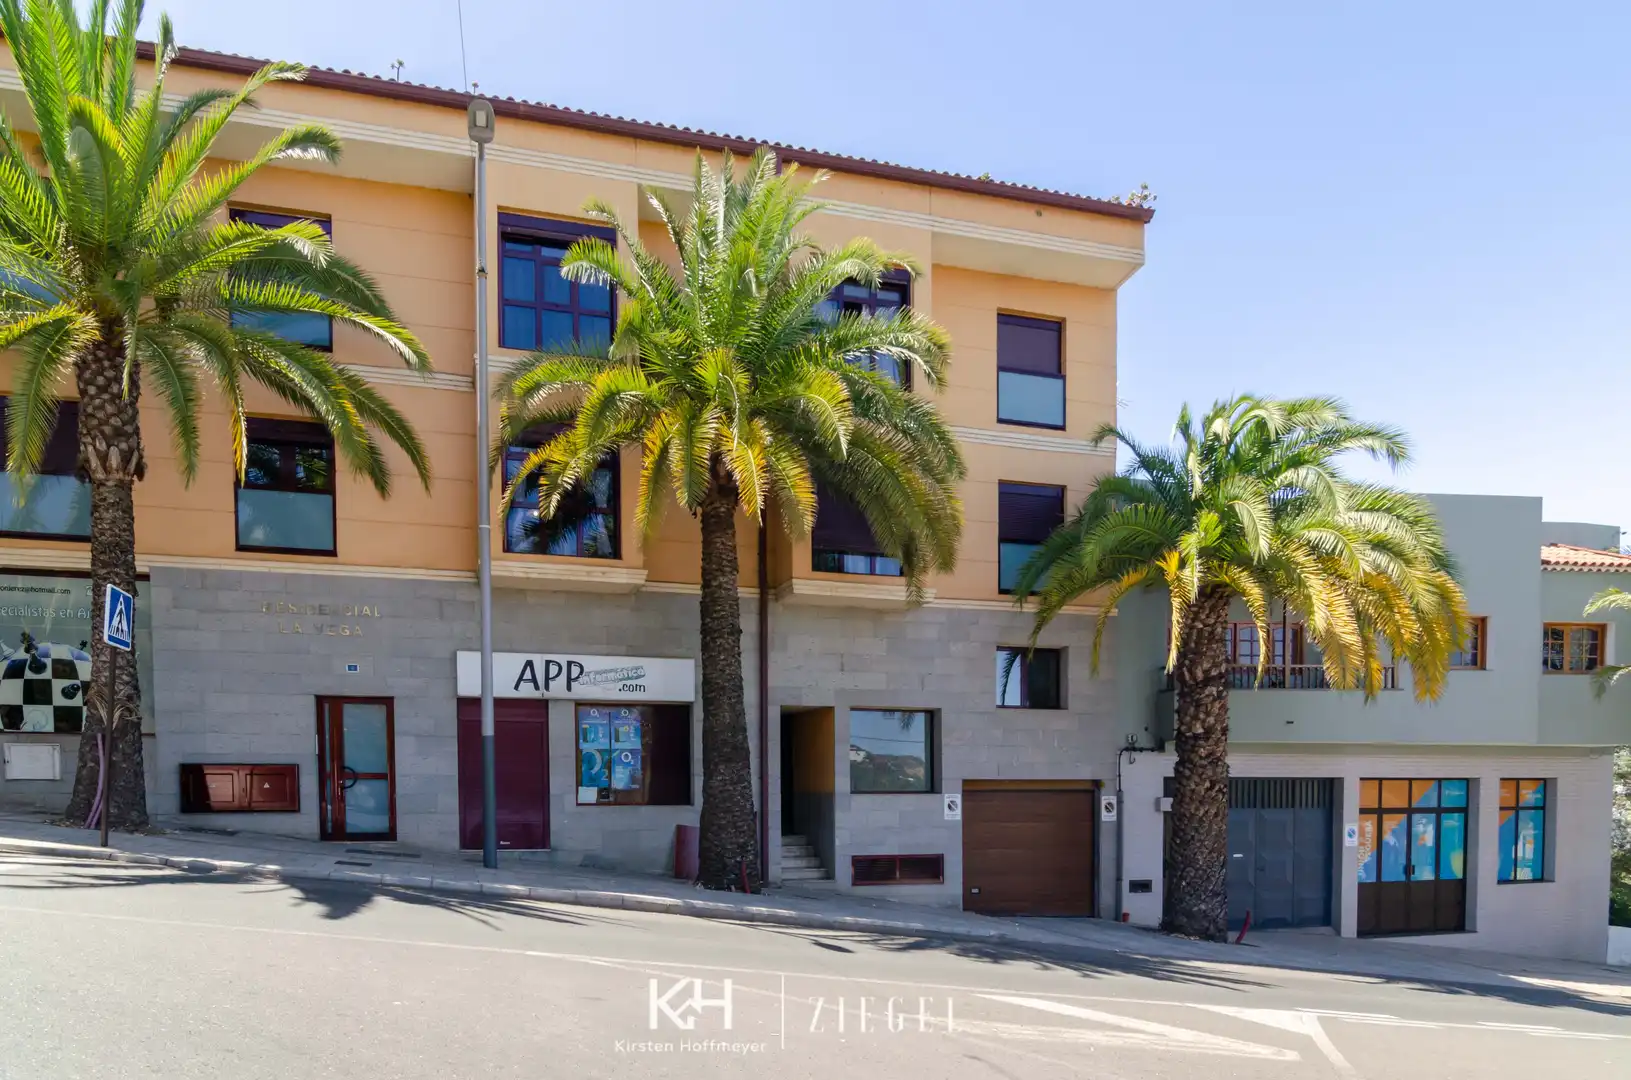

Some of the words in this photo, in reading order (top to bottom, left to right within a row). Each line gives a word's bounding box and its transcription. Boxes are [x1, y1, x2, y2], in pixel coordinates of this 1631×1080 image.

[0, 604, 56, 618] ecialistas
[60, 609, 74, 618] en
[279, 621, 302, 635] LA
[313, 623, 364, 638] VEGA
[513, 659, 585, 693] APP
[618, 683, 646, 693] .com
